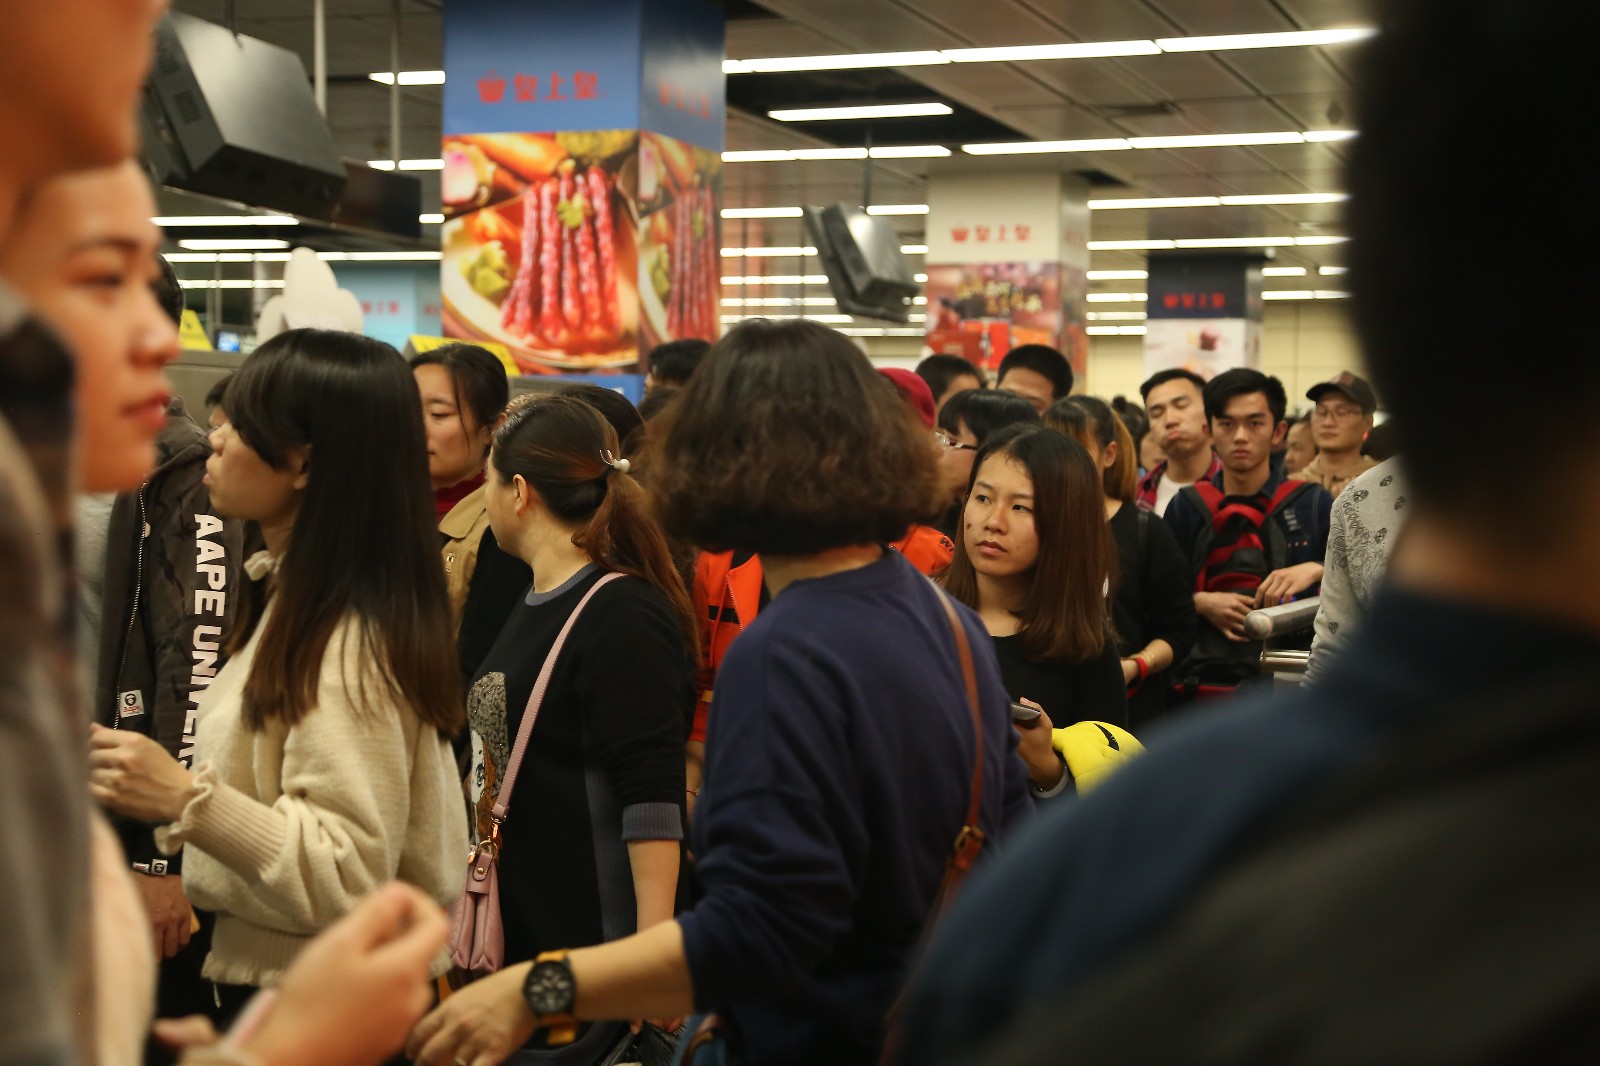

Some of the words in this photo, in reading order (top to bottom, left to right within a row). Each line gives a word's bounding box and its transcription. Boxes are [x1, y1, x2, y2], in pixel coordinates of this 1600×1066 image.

[513, 70, 598, 102] 皇上皇
[194, 513, 226, 617] AAPE
